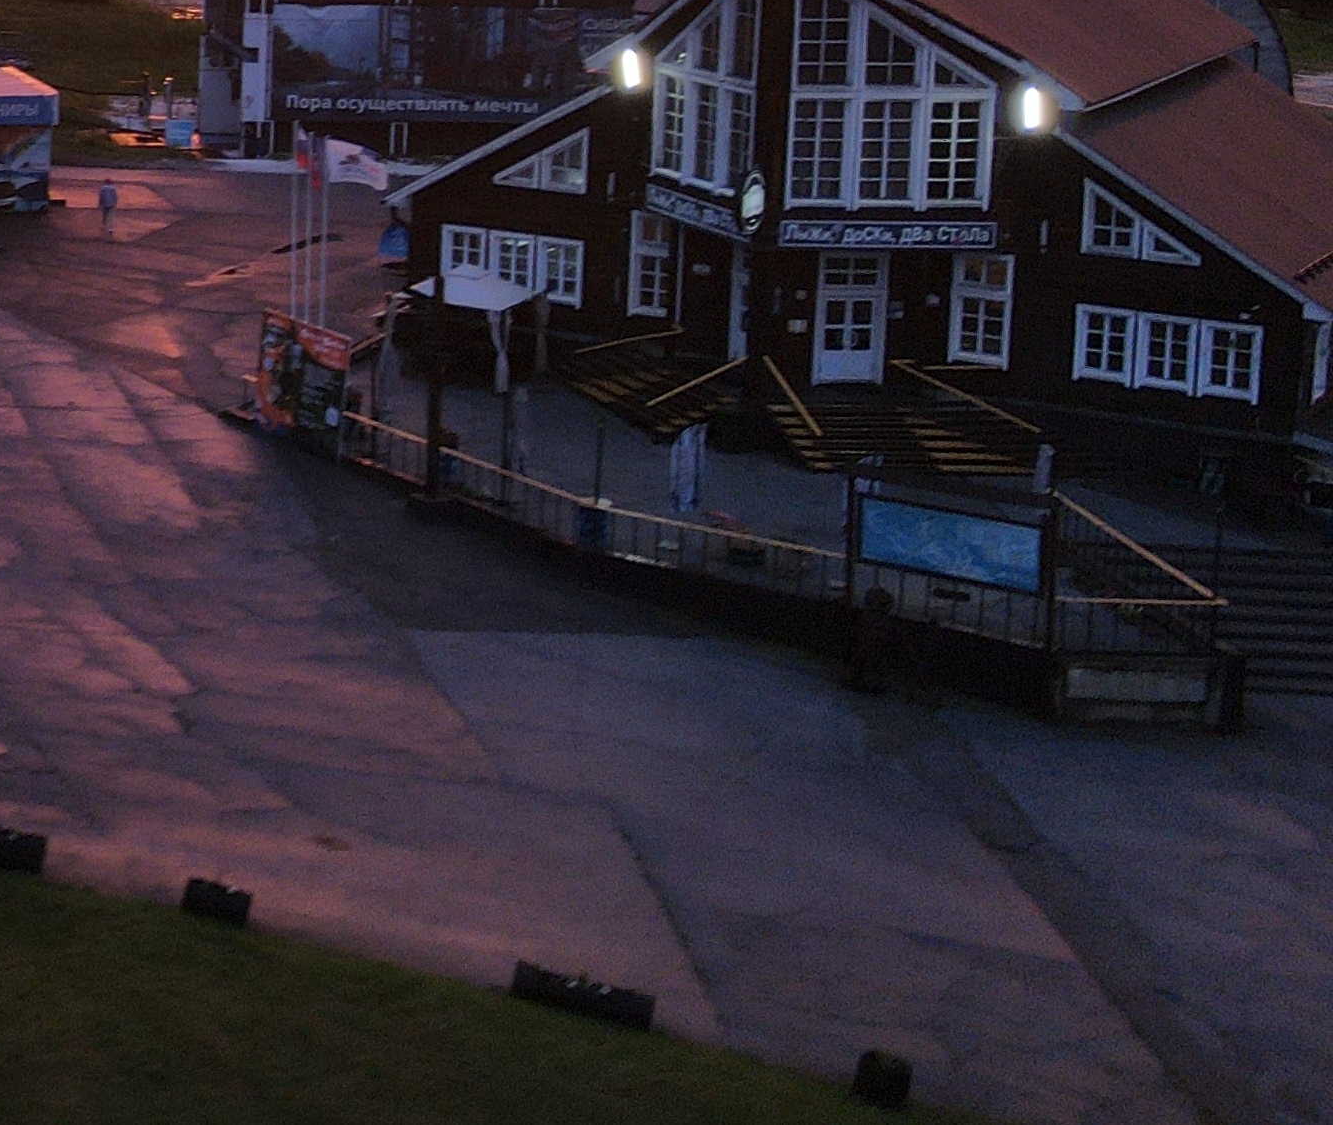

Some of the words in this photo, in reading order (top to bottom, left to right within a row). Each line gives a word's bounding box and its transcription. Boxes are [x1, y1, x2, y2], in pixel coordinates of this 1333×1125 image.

[286, 94, 331, 112] Пора
[336, 96, 469, 115] осуществлять
[475, 100, 539, 115] мечты
